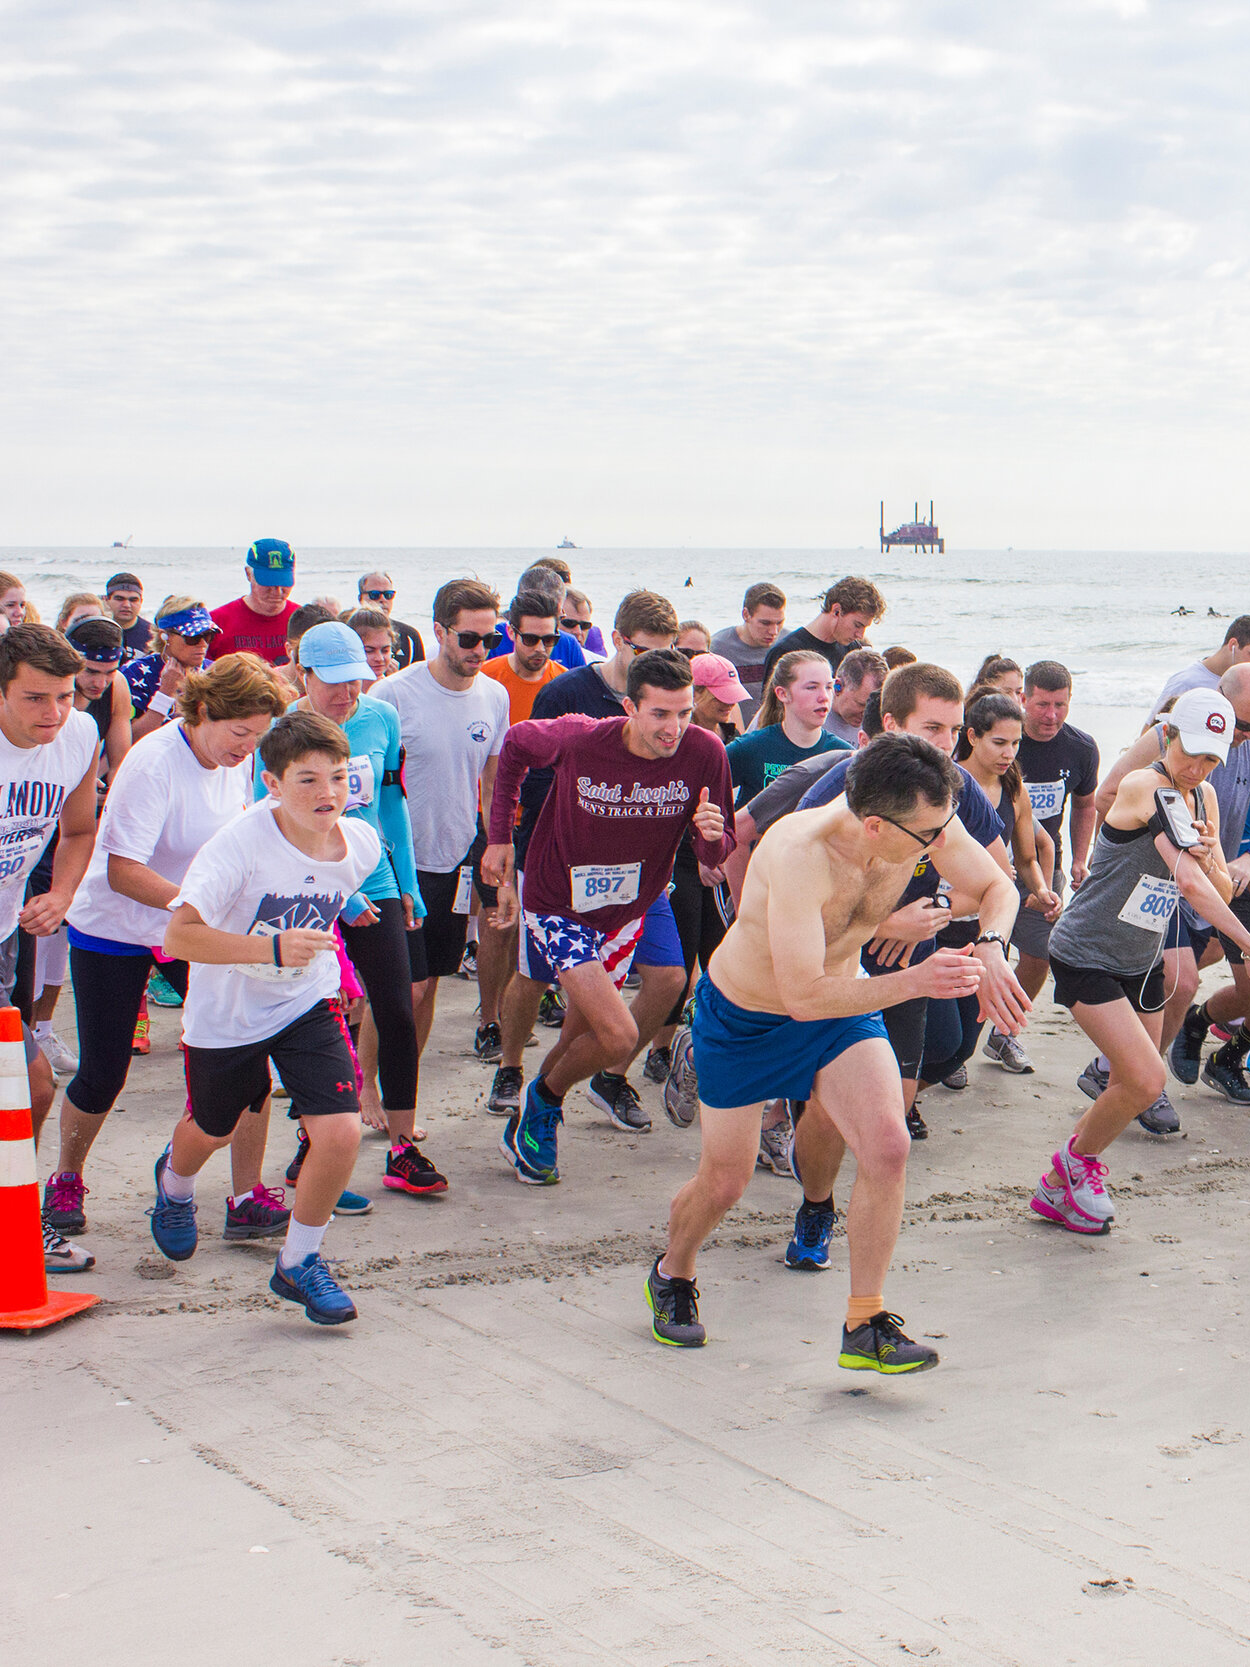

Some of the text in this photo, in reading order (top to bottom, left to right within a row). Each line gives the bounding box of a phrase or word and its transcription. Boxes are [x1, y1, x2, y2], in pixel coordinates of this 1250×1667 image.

[577, 777, 690, 807] Saint Joseph's
[578, 796, 685, 817] MEN'S TRACK & FIELD
[585, 876, 626, 897] 897
